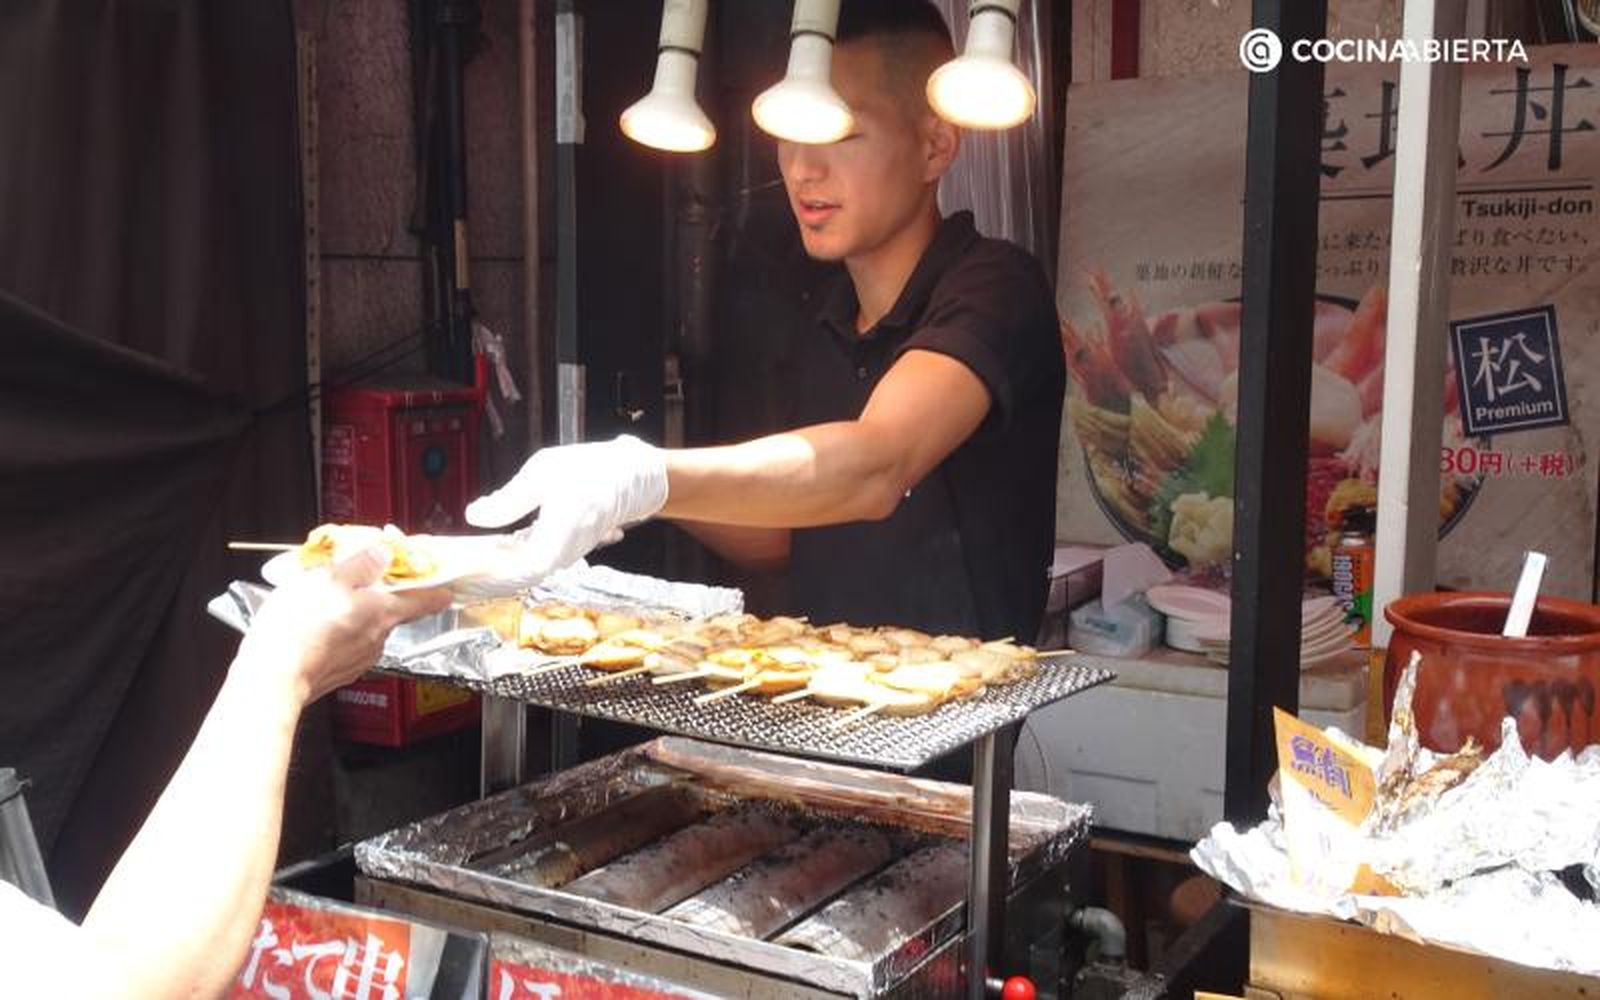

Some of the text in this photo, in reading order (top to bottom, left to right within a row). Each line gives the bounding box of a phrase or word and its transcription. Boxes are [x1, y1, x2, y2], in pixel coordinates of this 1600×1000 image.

[1461, 197, 1593, 220] Tsukiji-don
[1471, 332, 1546, 403] 松
[1475, 400, 1554, 421] Premium
